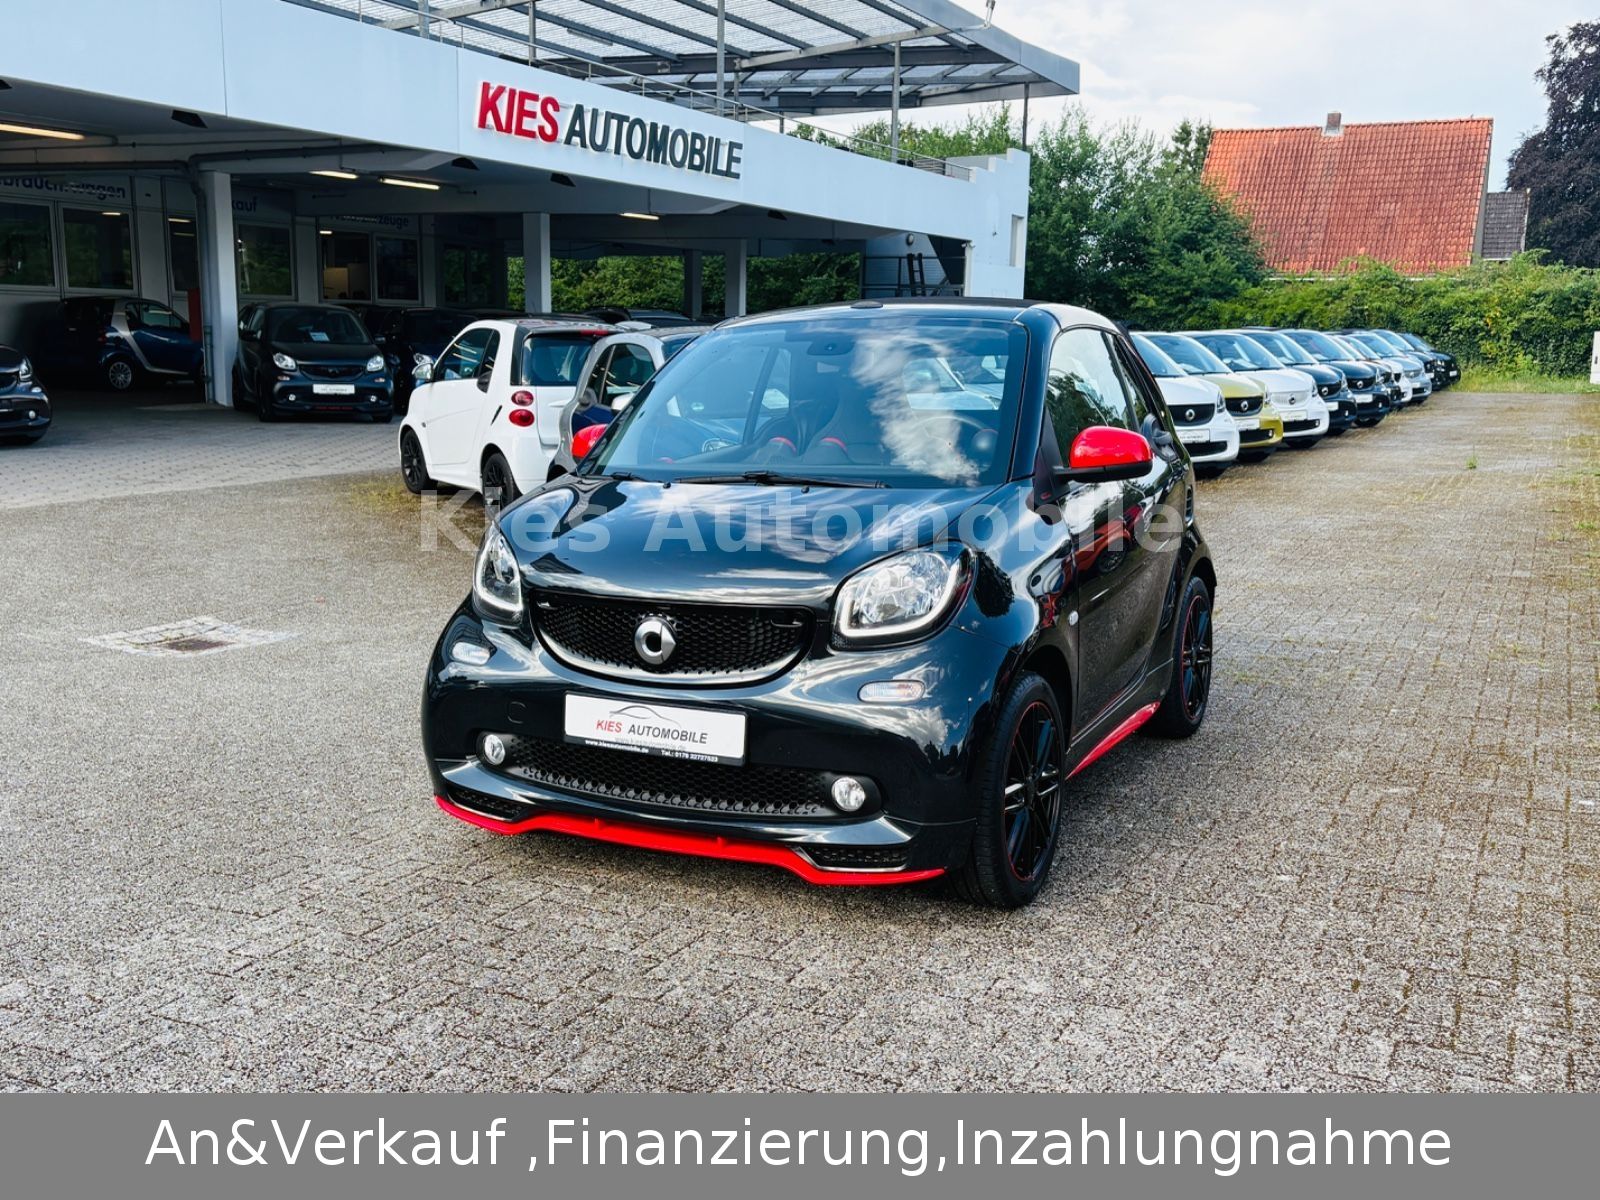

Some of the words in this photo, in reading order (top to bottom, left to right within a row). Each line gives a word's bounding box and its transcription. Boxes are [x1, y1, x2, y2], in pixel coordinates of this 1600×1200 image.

[477, 81, 560, 143] KIES
[563, 103, 743, 180] AUTOMOBILE
[596, 719, 623, 733] KIES
[628, 724, 709, 744] AUTOMOBILE
